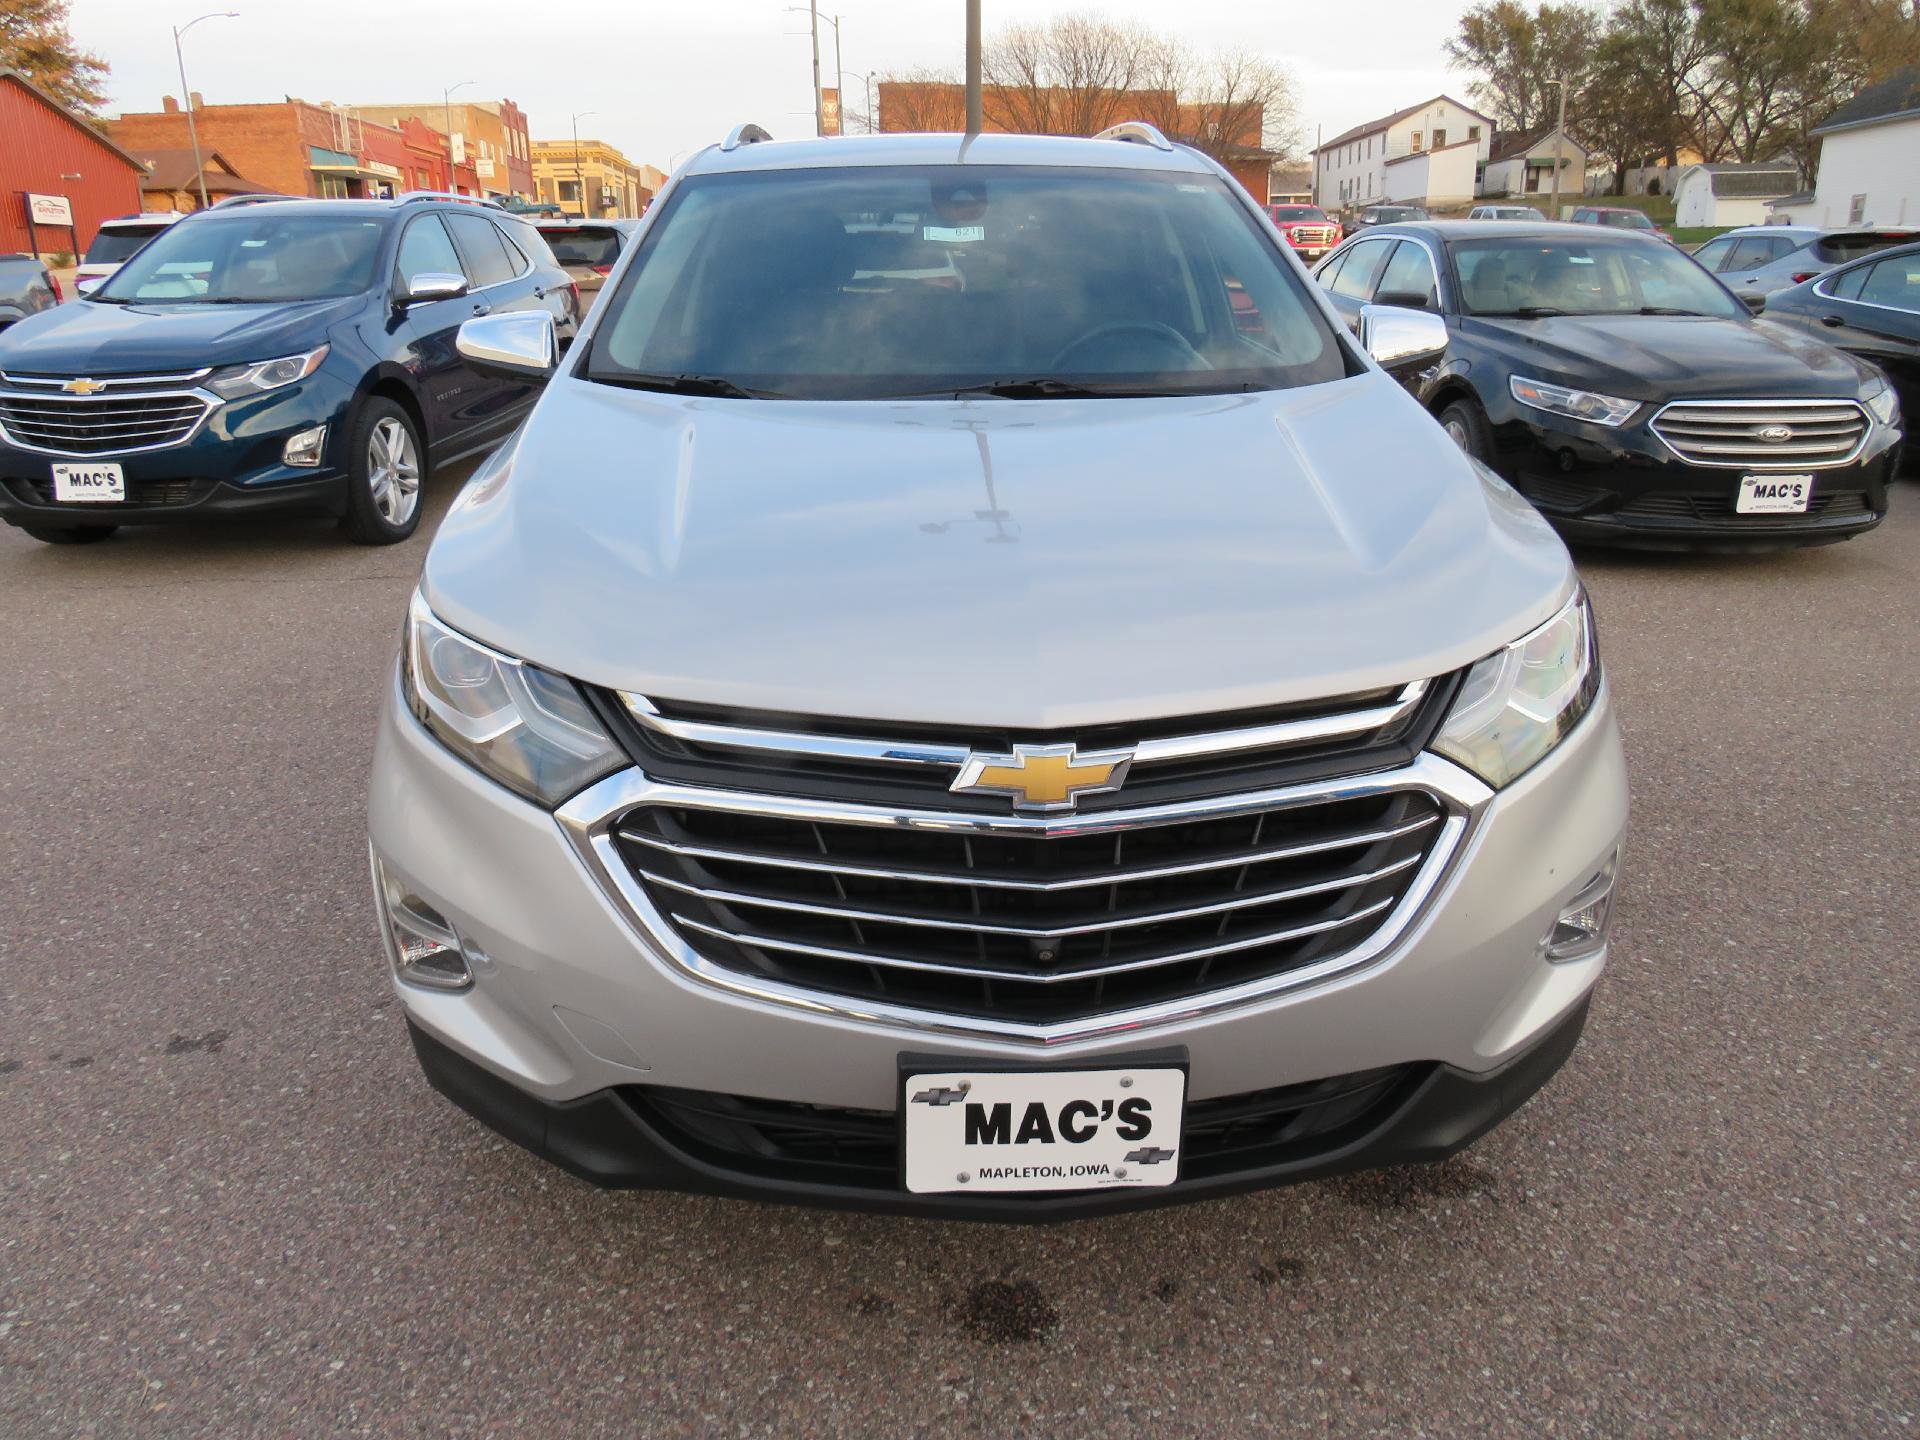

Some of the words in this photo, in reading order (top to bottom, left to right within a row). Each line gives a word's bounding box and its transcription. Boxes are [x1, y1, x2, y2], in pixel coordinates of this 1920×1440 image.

[69, 472, 116, 486] MAC'S
[1753, 484, 1802, 498] MAC'S
[965, 1097, 1152, 1145] MAC'S
[979, 1165, 1067, 1179] MAPLETON,
[1070, 1163, 1110, 1177] IOWA
